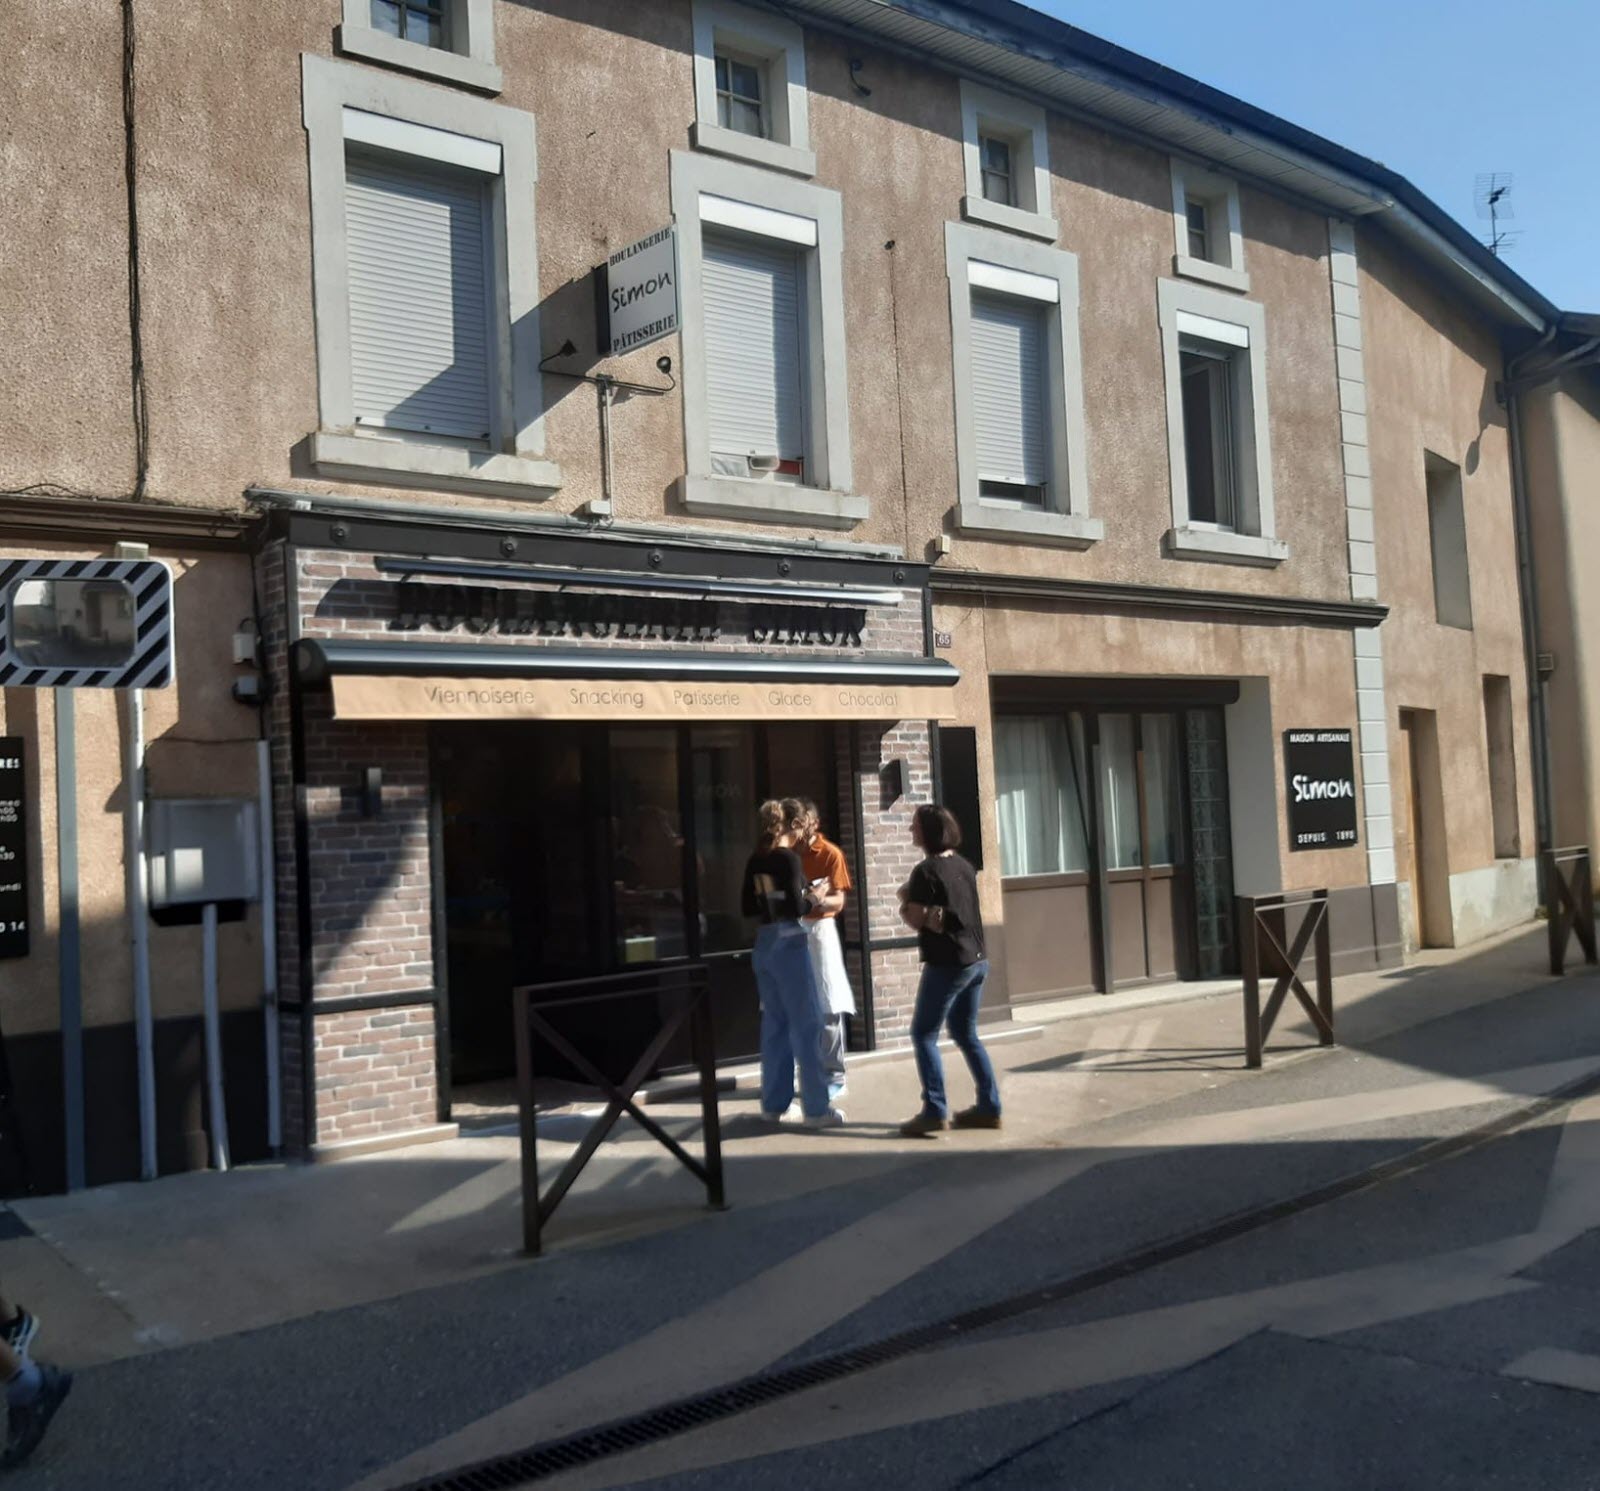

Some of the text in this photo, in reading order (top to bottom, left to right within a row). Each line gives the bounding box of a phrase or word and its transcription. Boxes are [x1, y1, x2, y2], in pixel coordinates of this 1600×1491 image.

[609, 227, 671, 266] BOULANGERIE
[611, 272, 672, 313] Simon
[425, 686, 535, 704] Viennoiserie
[570, 687, 644, 708] Snacking
[768, 691, 812, 706] Glace
[838, 692, 899, 706] Chocolat
[1289, 733, 1350, 742] MAISON ARTISANALE
[1292, 774, 1353, 803] Simon
[1298, 832, 1326, 844] DEPUIS
